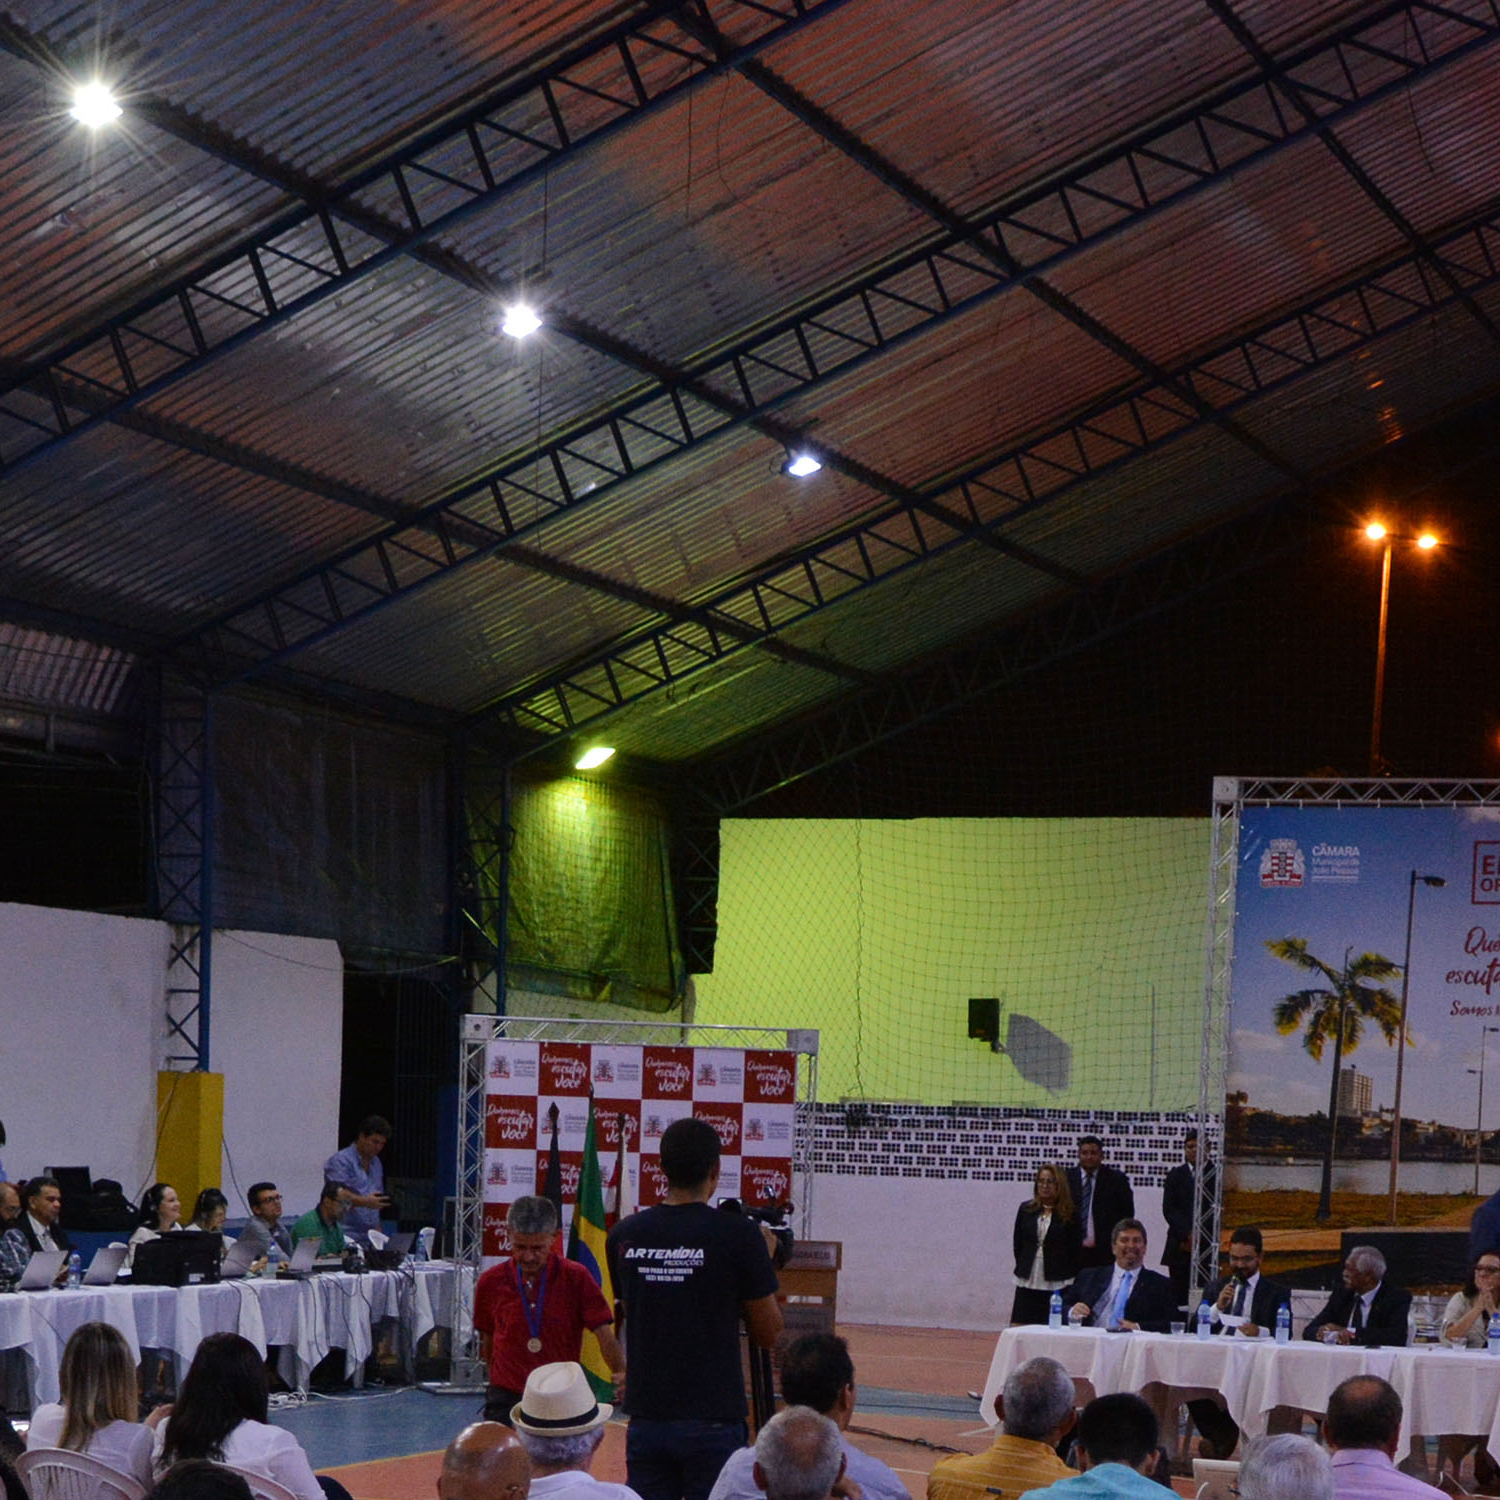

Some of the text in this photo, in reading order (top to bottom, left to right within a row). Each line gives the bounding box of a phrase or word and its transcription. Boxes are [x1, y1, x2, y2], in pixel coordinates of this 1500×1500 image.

[1312, 842, 1361, 857] CÂMARA
[1450, 1000, 1493, 1016] Somos
[625, 1245, 704, 1260] ARTEMÍDIA
